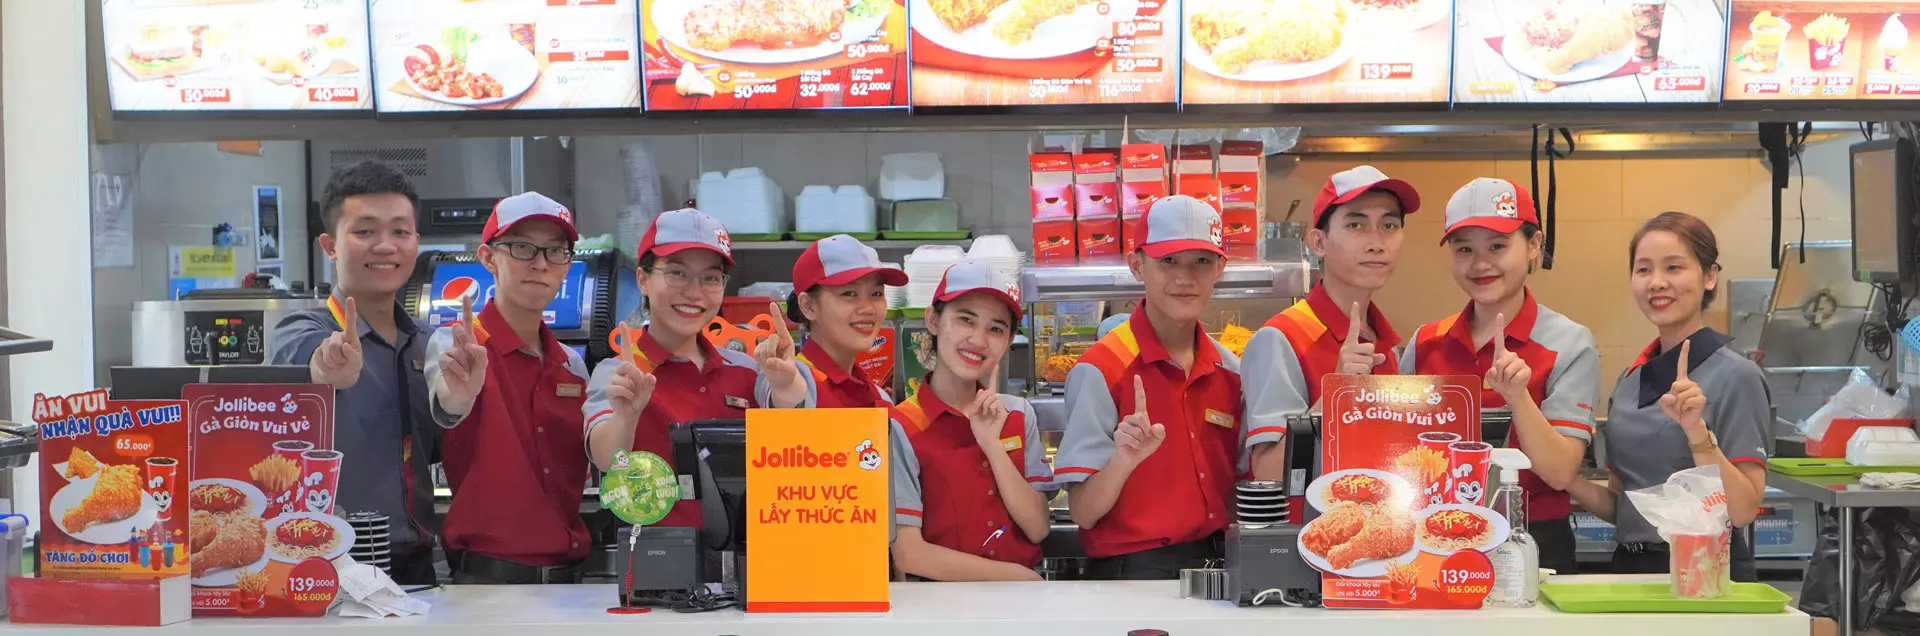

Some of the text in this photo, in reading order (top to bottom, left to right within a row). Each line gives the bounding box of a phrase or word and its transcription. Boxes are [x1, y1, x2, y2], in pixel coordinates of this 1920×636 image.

[213, 397, 276, 412] Jollibee
[1355, 388, 1420, 403] Jollibee
[34, 392, 107, 420] ĂN VUI
[1341, 406, 1457, 425] Gà Giòn Vui Vẻ
[41, 404, 181, 440] NHẬN QUÀ VUI!!
[199, 415, 310, 434] Gà Giòn Vui Vẻ
[752, 445, 848, 468] Jollibee
[777, 484, 858, 504] KHU VỰC
[759, 503, 876, 523] LẤY THỨC ĂN
[99, 552, 129, 564] CHƠI
